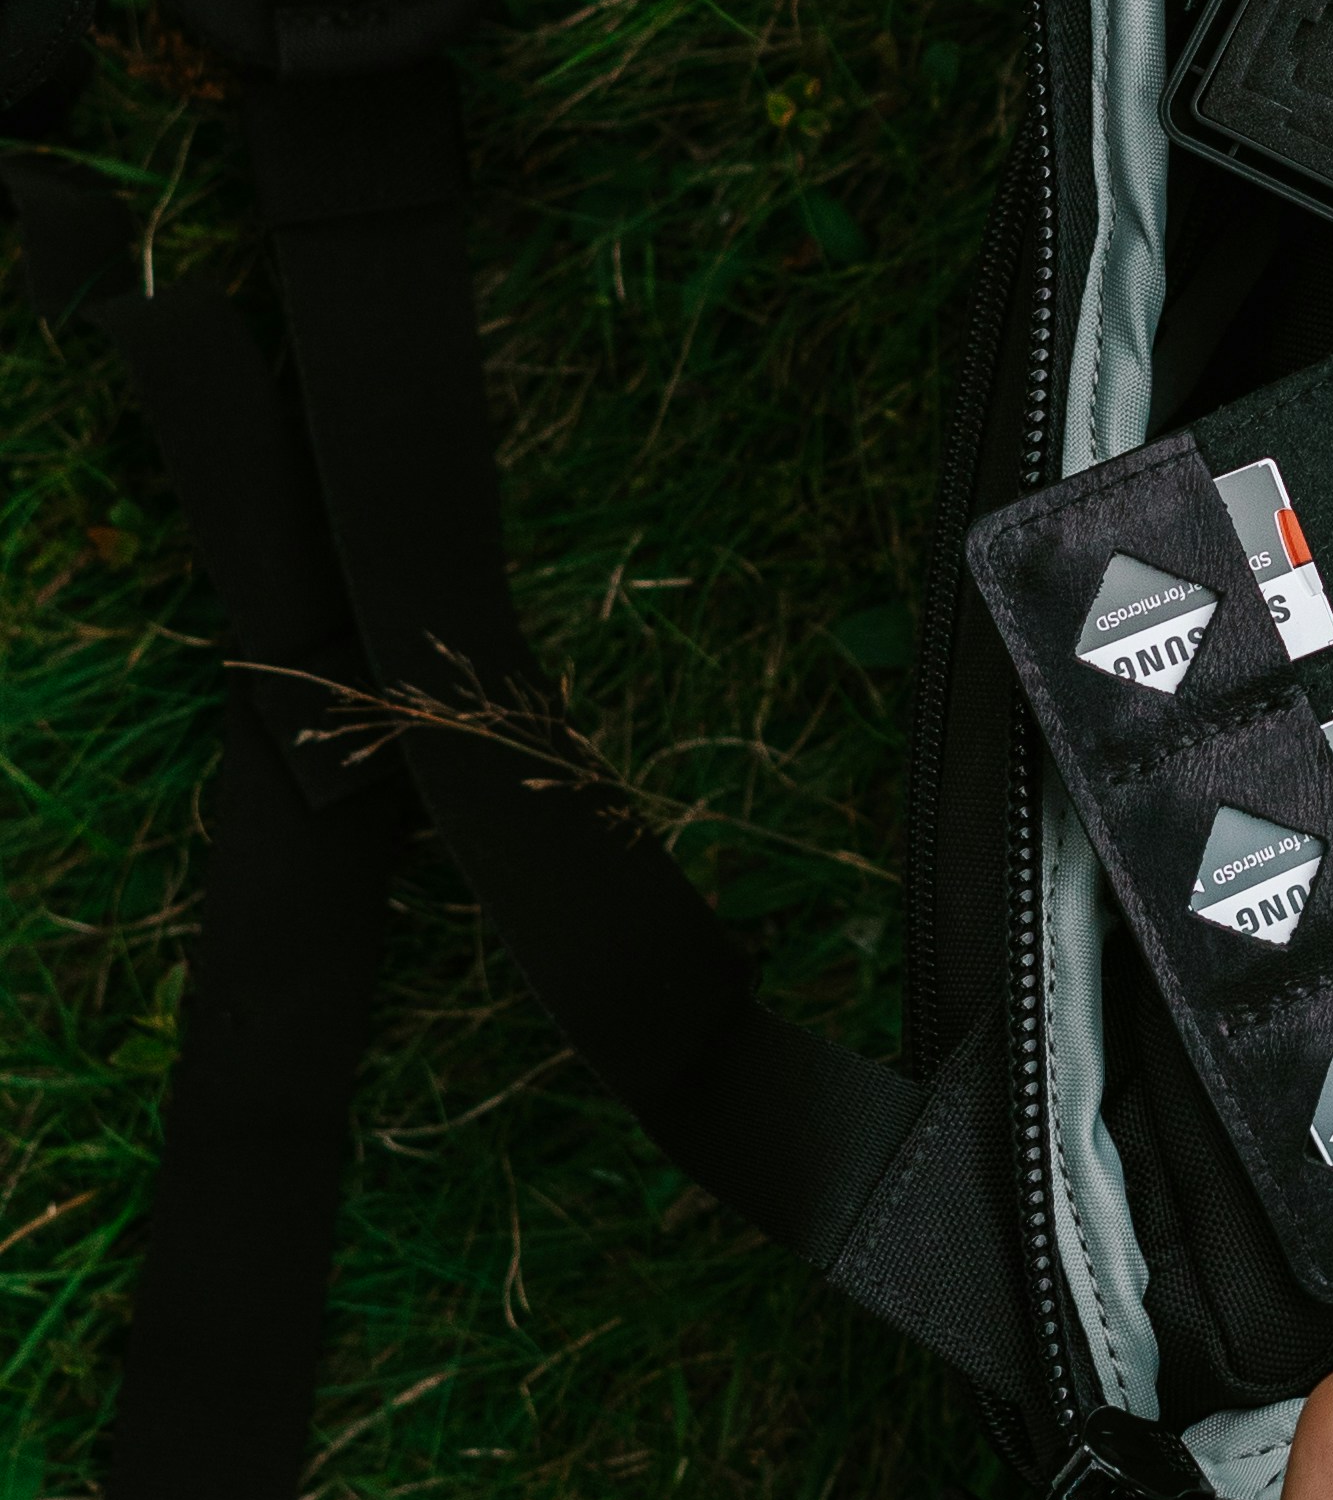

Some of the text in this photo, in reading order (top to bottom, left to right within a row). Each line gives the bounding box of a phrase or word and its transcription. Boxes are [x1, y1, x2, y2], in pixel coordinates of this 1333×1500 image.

[1250, 551, 1271, 571] SD
[1163, 585, 1185, 603] for
[1096, 595, 1161, 631] microSD
[1213, 834, 1301, 885] for microSD
